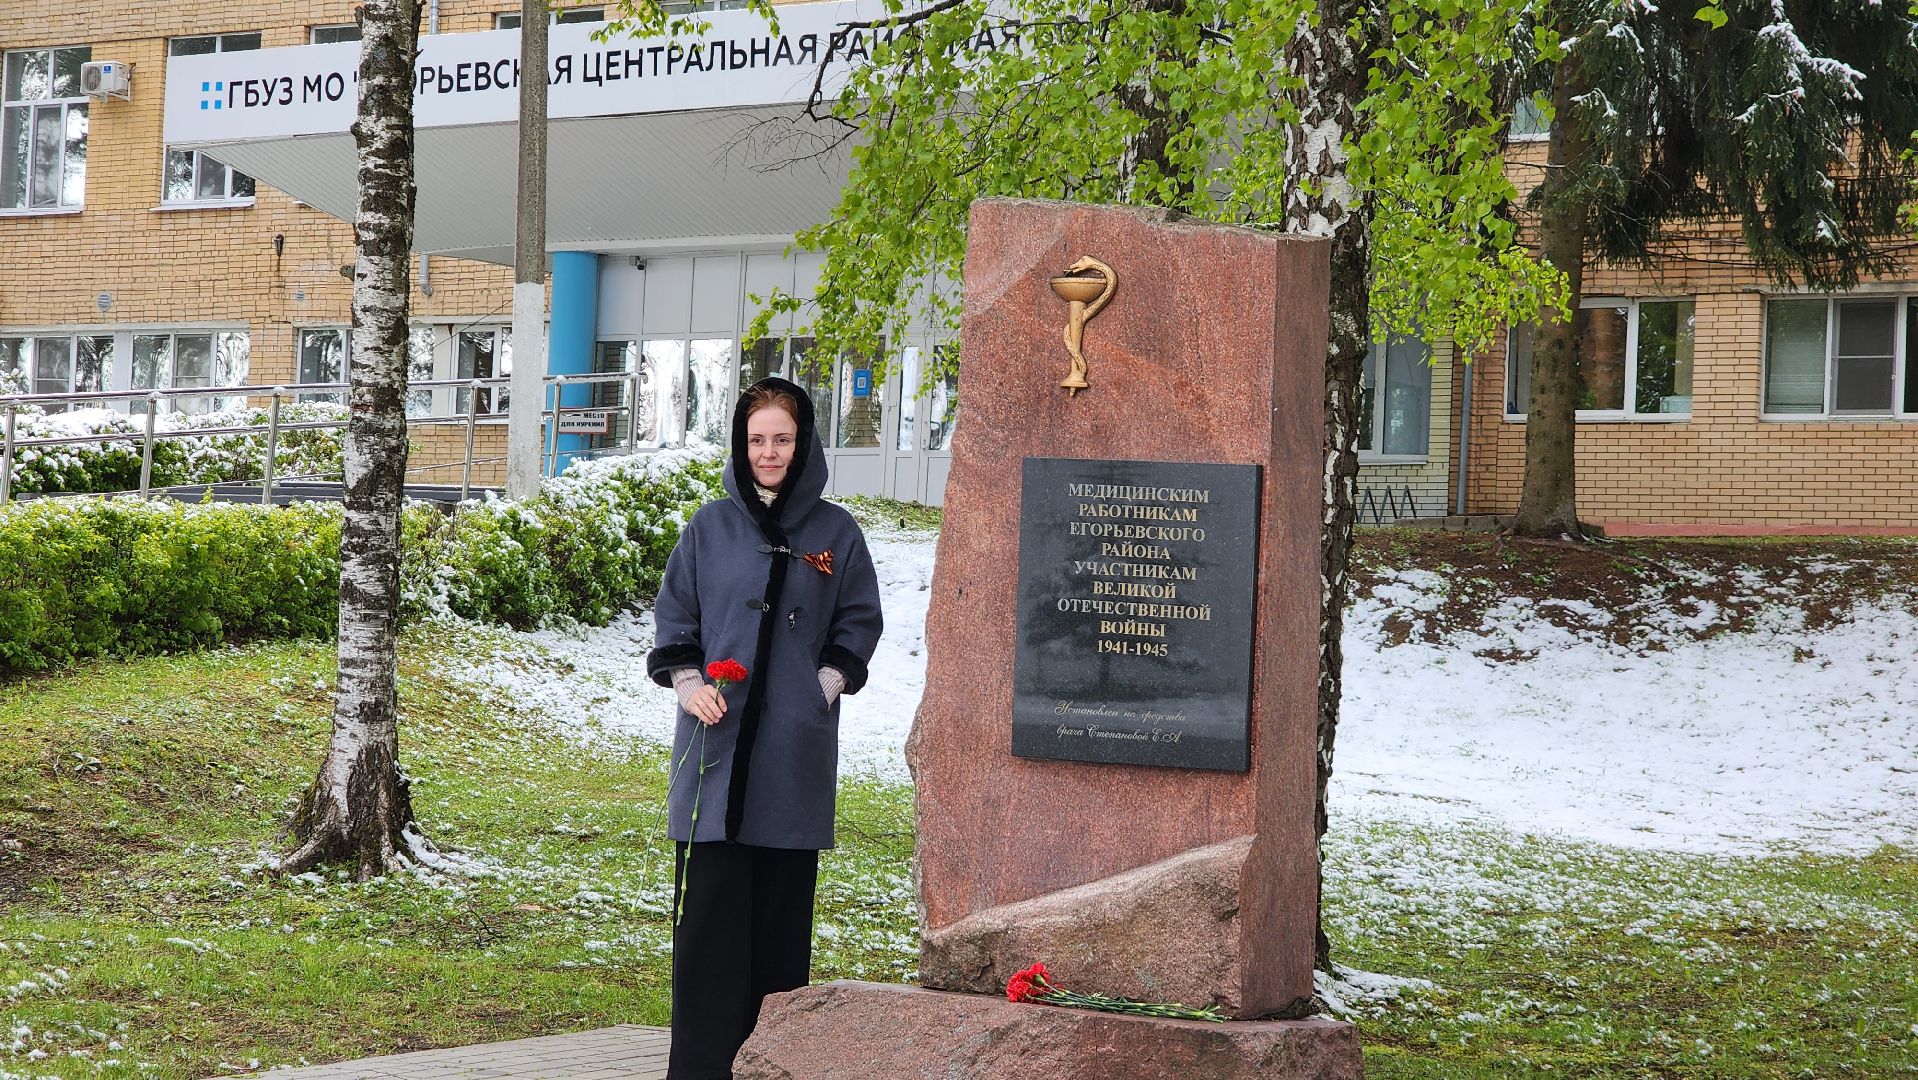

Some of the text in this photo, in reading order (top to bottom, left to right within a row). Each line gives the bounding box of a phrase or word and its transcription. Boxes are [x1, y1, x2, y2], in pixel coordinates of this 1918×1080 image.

[229, 77, 293, 108] ГБУЗ
[303, 72, 345, 103] МО
[583, 33, 818, 87] ЦЕНТРАЛЬНАЯ
[1068, 483, 1210, 503] МЕДИЦИНСКИМ
[1078, 503, 1198, 522] РАБОТНИКАМ
[1069, 522, 1206, 542] ЕГОРЬЕВСКОГО
[1101, 540, 1171, 560] РАЙОНА
[1074, 560, 1197, 580] УЧАСТНИКАМ
[1093, 581, 1176, 599] ВЕЛИКОЙ
[1057, 598, 1212, 620] ОТЕЧЕСТВЕННОЙ
[1100, 619, 1166, 637] ВОЙНЫ
[1097, 640, 1168, 657] 1941-1945
[1054, 700, 1119, 717] Установлен
[1141, 709, 1186, 725] средства
[1056, 722, 1084, 739] врача
[1086, 723, 1150, 741] Степановой
